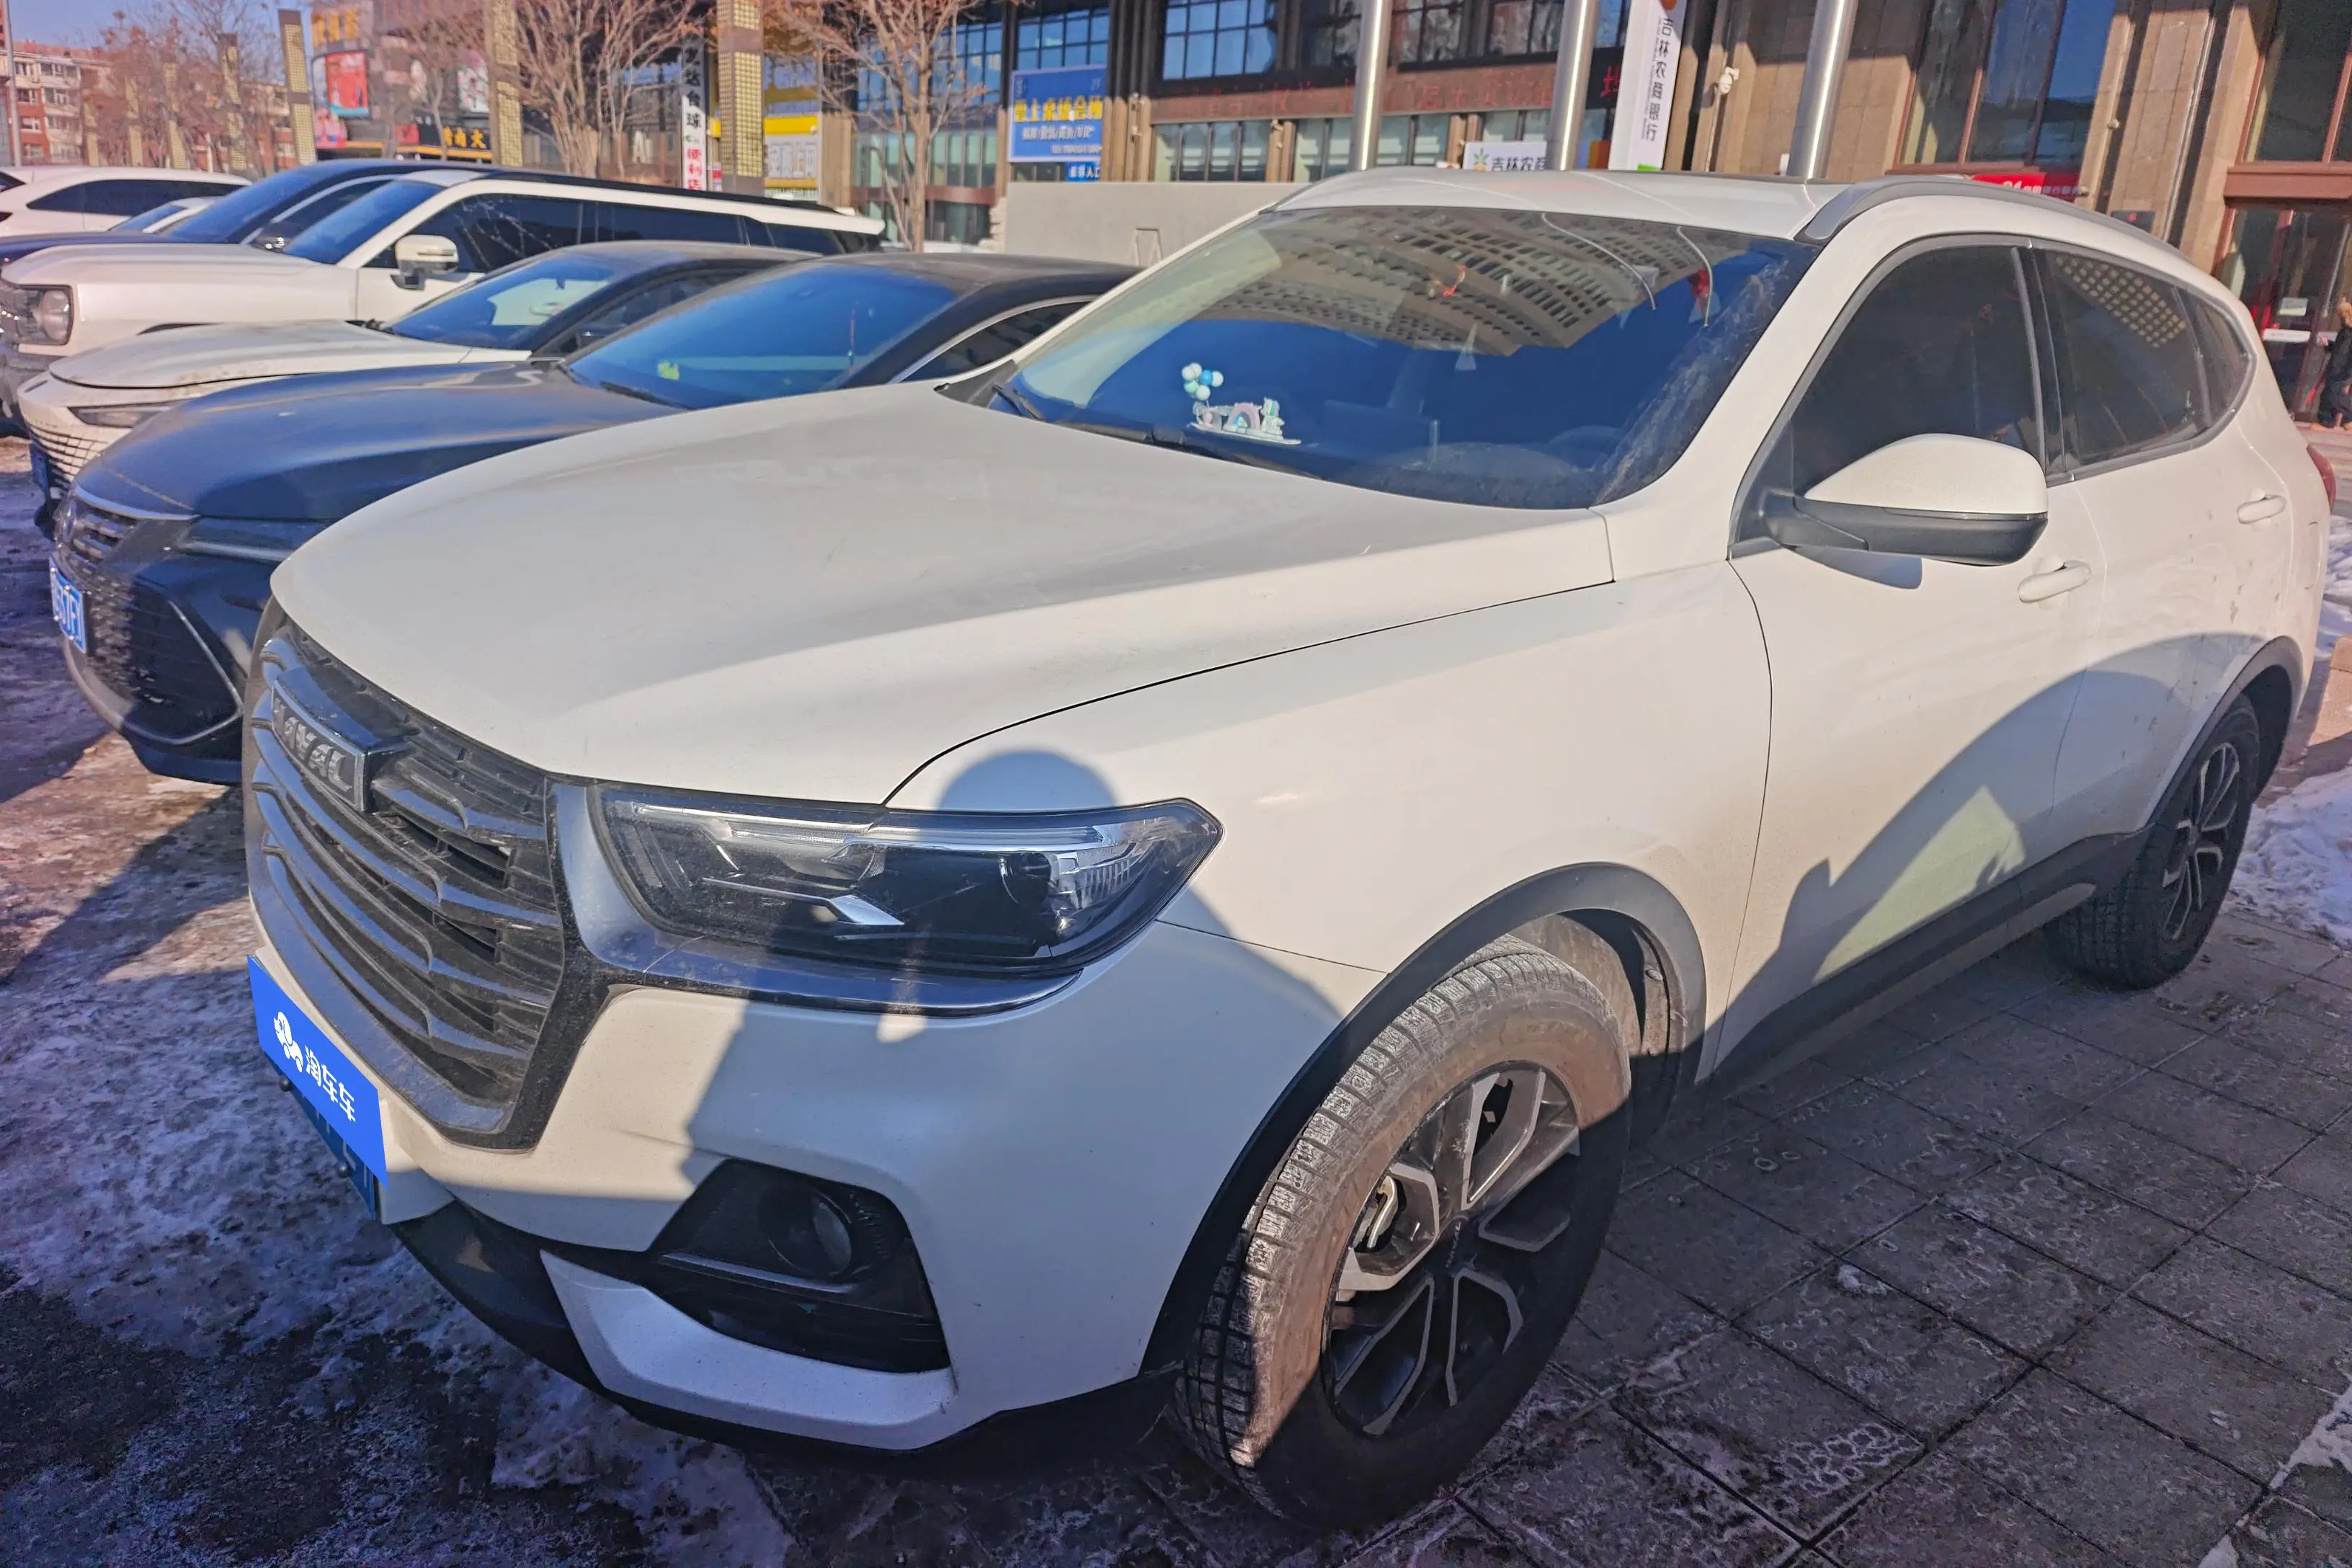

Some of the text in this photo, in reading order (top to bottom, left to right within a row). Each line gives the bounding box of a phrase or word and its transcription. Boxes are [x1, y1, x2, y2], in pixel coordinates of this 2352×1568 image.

[1646, 17, 1674, 142] 吉林农商银行
[273, 697, 352, 793] HAVAL
